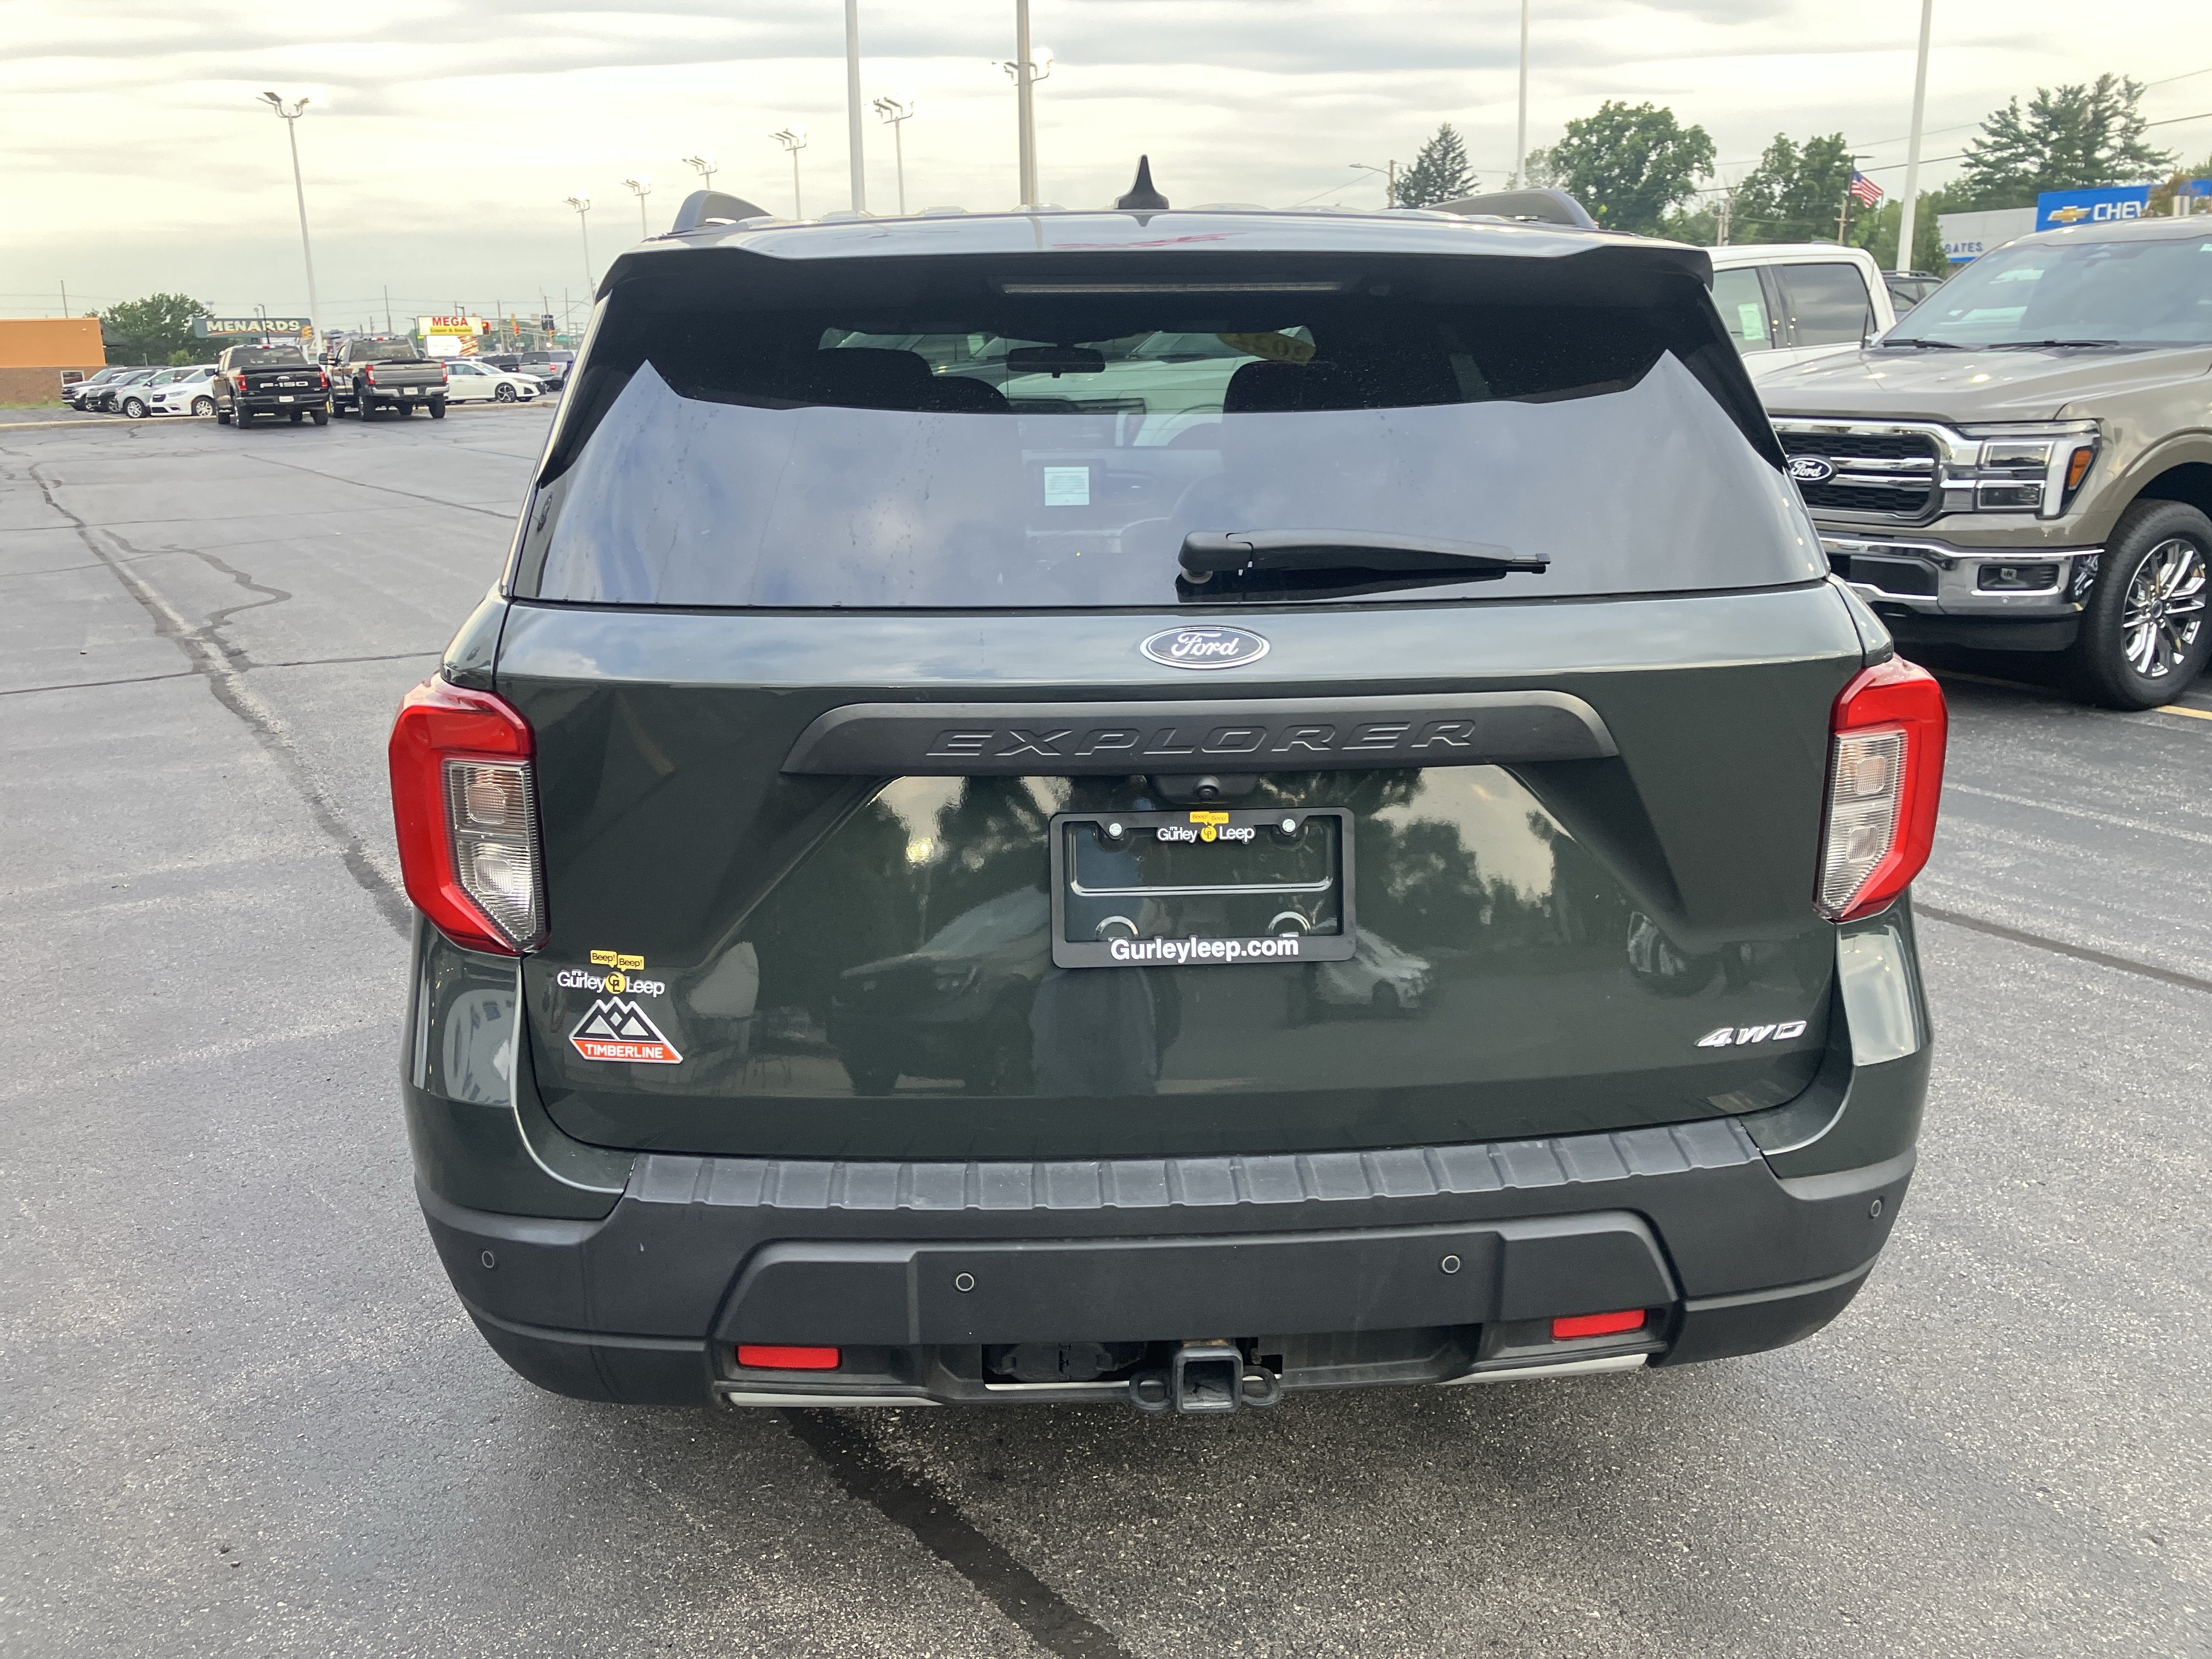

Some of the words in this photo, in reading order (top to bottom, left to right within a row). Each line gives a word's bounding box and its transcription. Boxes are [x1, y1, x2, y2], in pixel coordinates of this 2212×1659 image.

[2092, 201, 2151, 221] CHEV
[1944, 241, 1983, 254] GATES
[206, 319, 301, 332] MENARDS
[432, 316, 469, 326] MEGA
[1790, 460, 1822, 477] Ford
[1171, 633, 1240, 656] Ford
[926, 719, 1477, 757] EXPLORER
[1158, 826, 1198, 843] Gurley
[1220, 826, 1255, 843] Leep
[1110, 938, 1299, 963] Gurleyleep.com
[592, 953, 616, 963] Beep!
[619, 958, 642, 968] Beep!
[557, 971, 606, 993] Gurley
[626, 977, 665, 997] Leep
[1696, 1020, 1807, 1047] 4WD
[584, 1043, 663, 1058] TIMBERLINE
